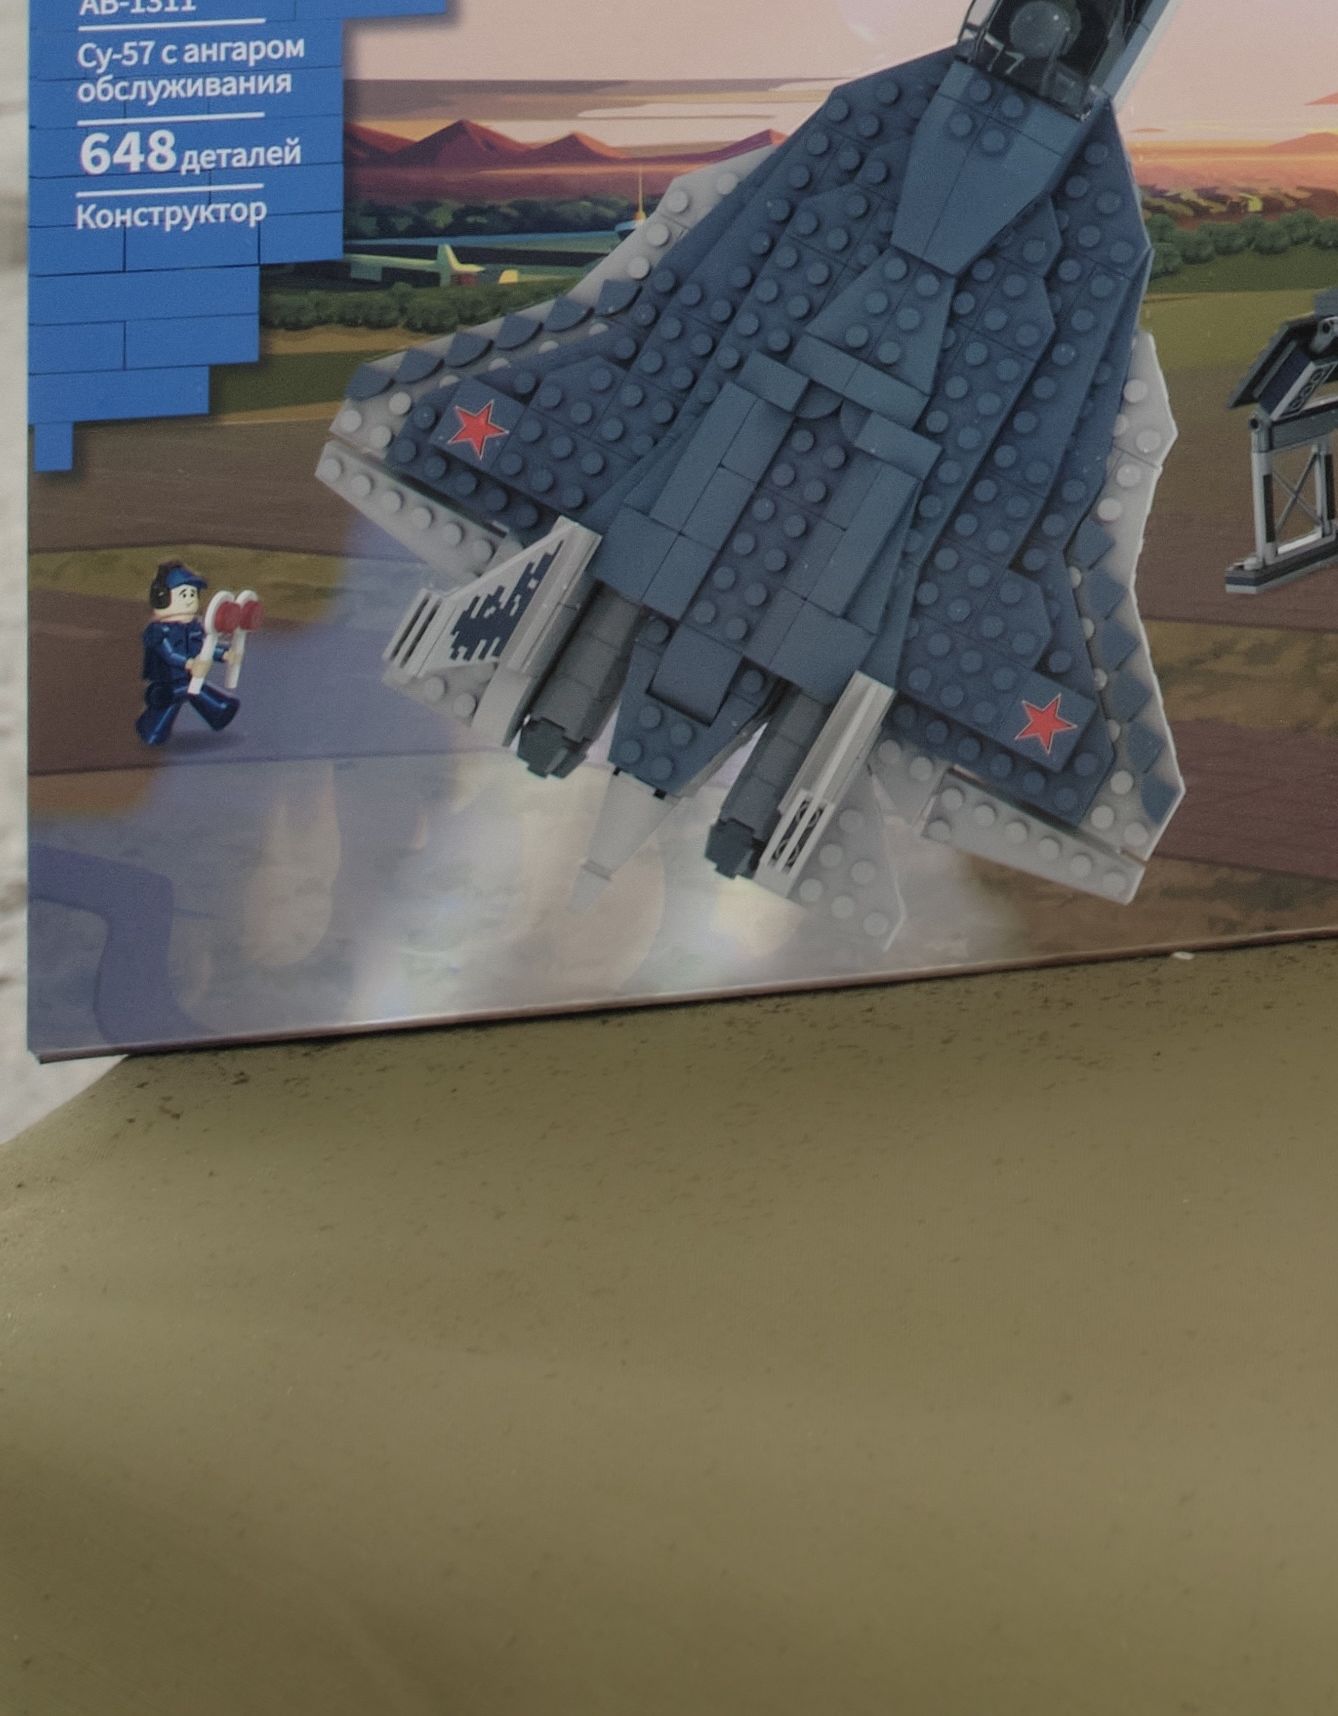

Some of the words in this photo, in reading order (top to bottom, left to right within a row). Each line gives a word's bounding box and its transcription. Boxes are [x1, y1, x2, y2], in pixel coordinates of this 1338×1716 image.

[77, 40, 155, 74] Су-57
[161, 44, 178, 65] с
[183, 38, 305, 68] ангаром
[77, 72, 292, 106] обслуживания
[80, 129, 177, 175] 648
[180, 137, 302, 175] деталей
[76, 200, 267, 232] Конструктор
